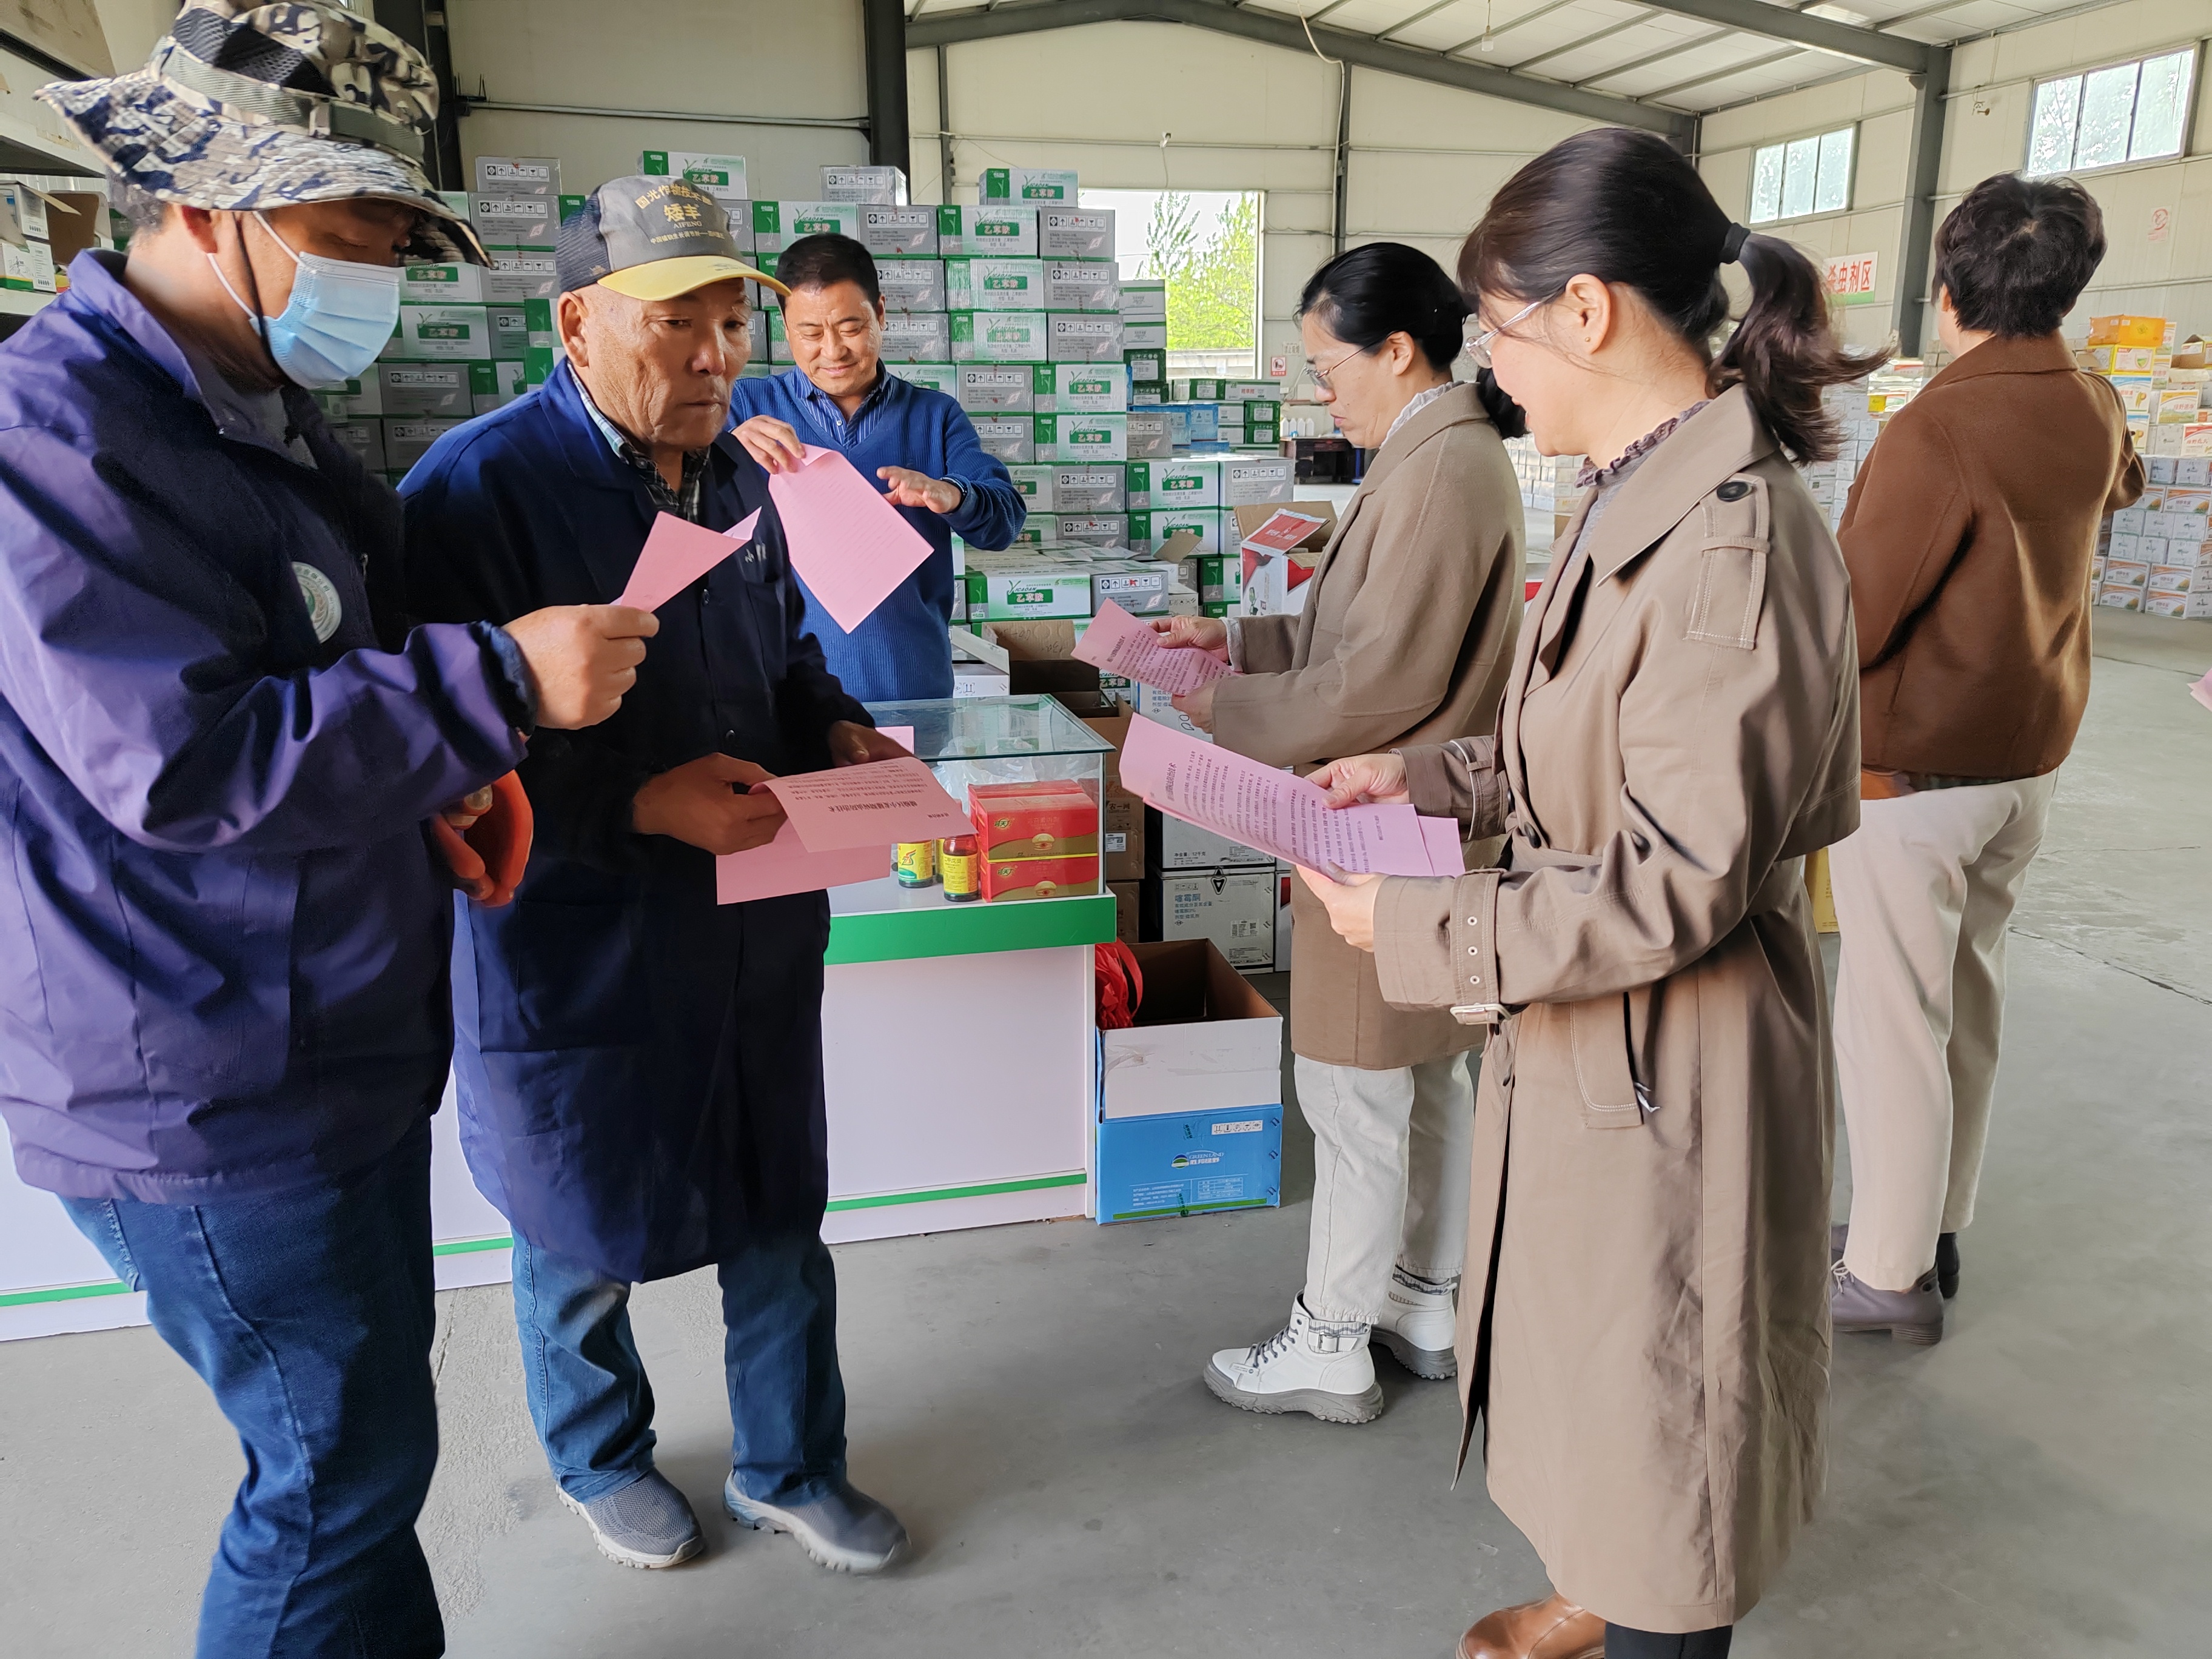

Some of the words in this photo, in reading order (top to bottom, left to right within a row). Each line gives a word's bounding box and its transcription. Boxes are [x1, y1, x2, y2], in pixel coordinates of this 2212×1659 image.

[663, 203, 702, 223] 矮丰
[1826, 260, 1872, 293] 杀虫剂区
